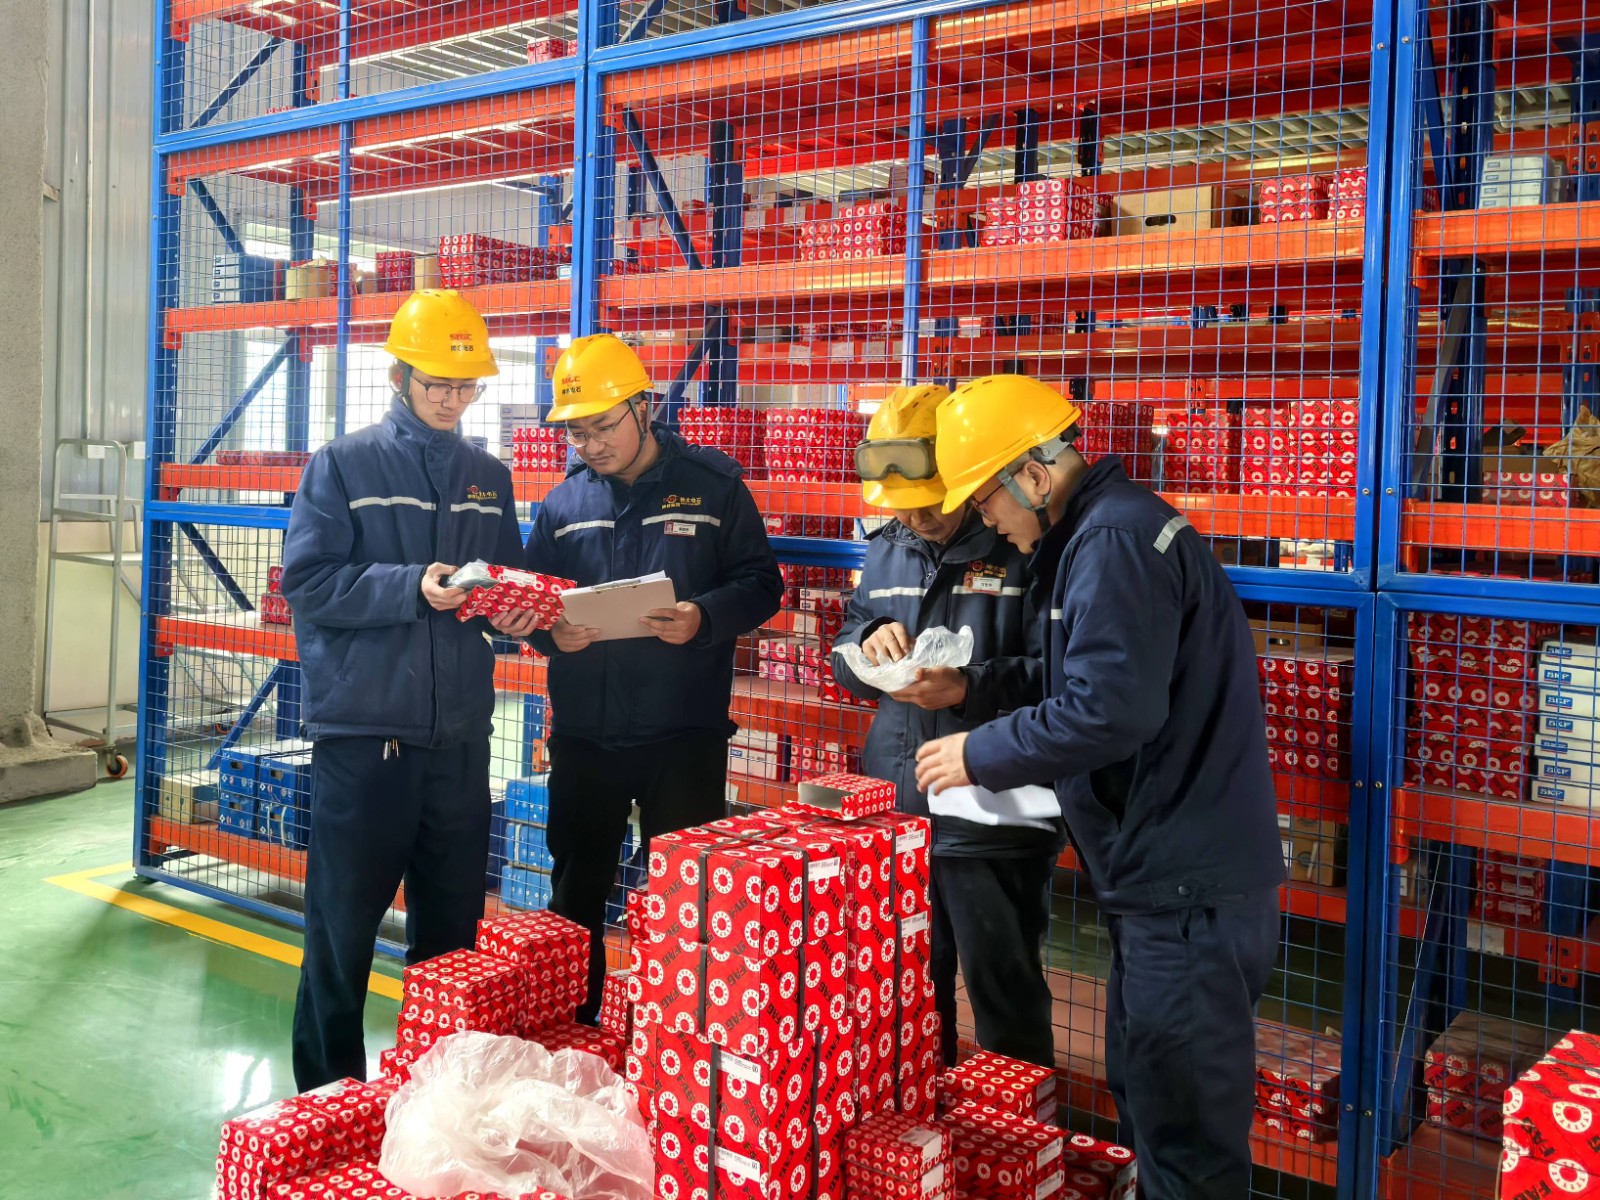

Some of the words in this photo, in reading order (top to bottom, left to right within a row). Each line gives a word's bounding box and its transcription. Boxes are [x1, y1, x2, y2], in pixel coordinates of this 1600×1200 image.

[870, 841, 883, 863] FAG
[779, 861, 792, 883] FAG
[914, 868, 926, 888] FAG
[663, 878, 683, 901] FAG
[827, 888, 841, 909] FAG
[869, 882, 882, 903] FAG
[729, 896, 748, 918] FAG
[777, 905, 791, 927] FAG
[871, 924, 885, 944] FAG
[662, 946, 681, 967] FAG
[820, 939, 834, 960] FAG
[727, 965, 747, 986] FAG
[768, 959, 783, 980] FAG
[869, 964, 883, 985] FAG
[661, 988, 680, 1009] FAG
[818, 981, 833, 1002] FAG
[725, 1009, 746, 1031] FAG
[767, 1003, 782, 1024] FAG
[677, 1033, 697, 1060] FAG
[825, 1034, 841, 1060] FAG
[776, 1058, 791, 1086] FAG
[678, 1074, 696, 1102] FAG
[824, 1076, 840, 1103] FAG
[743, 1098, 763, 1127] FAG
[775, 1101, 790, 1130] FAG
[678, 1116, 697, 1144] FAG
[1521, 1117, 1555, 1157] FAG
[678, 1160, 695, 1187] FAG
[780, 1149, 794, 1178] FAG
